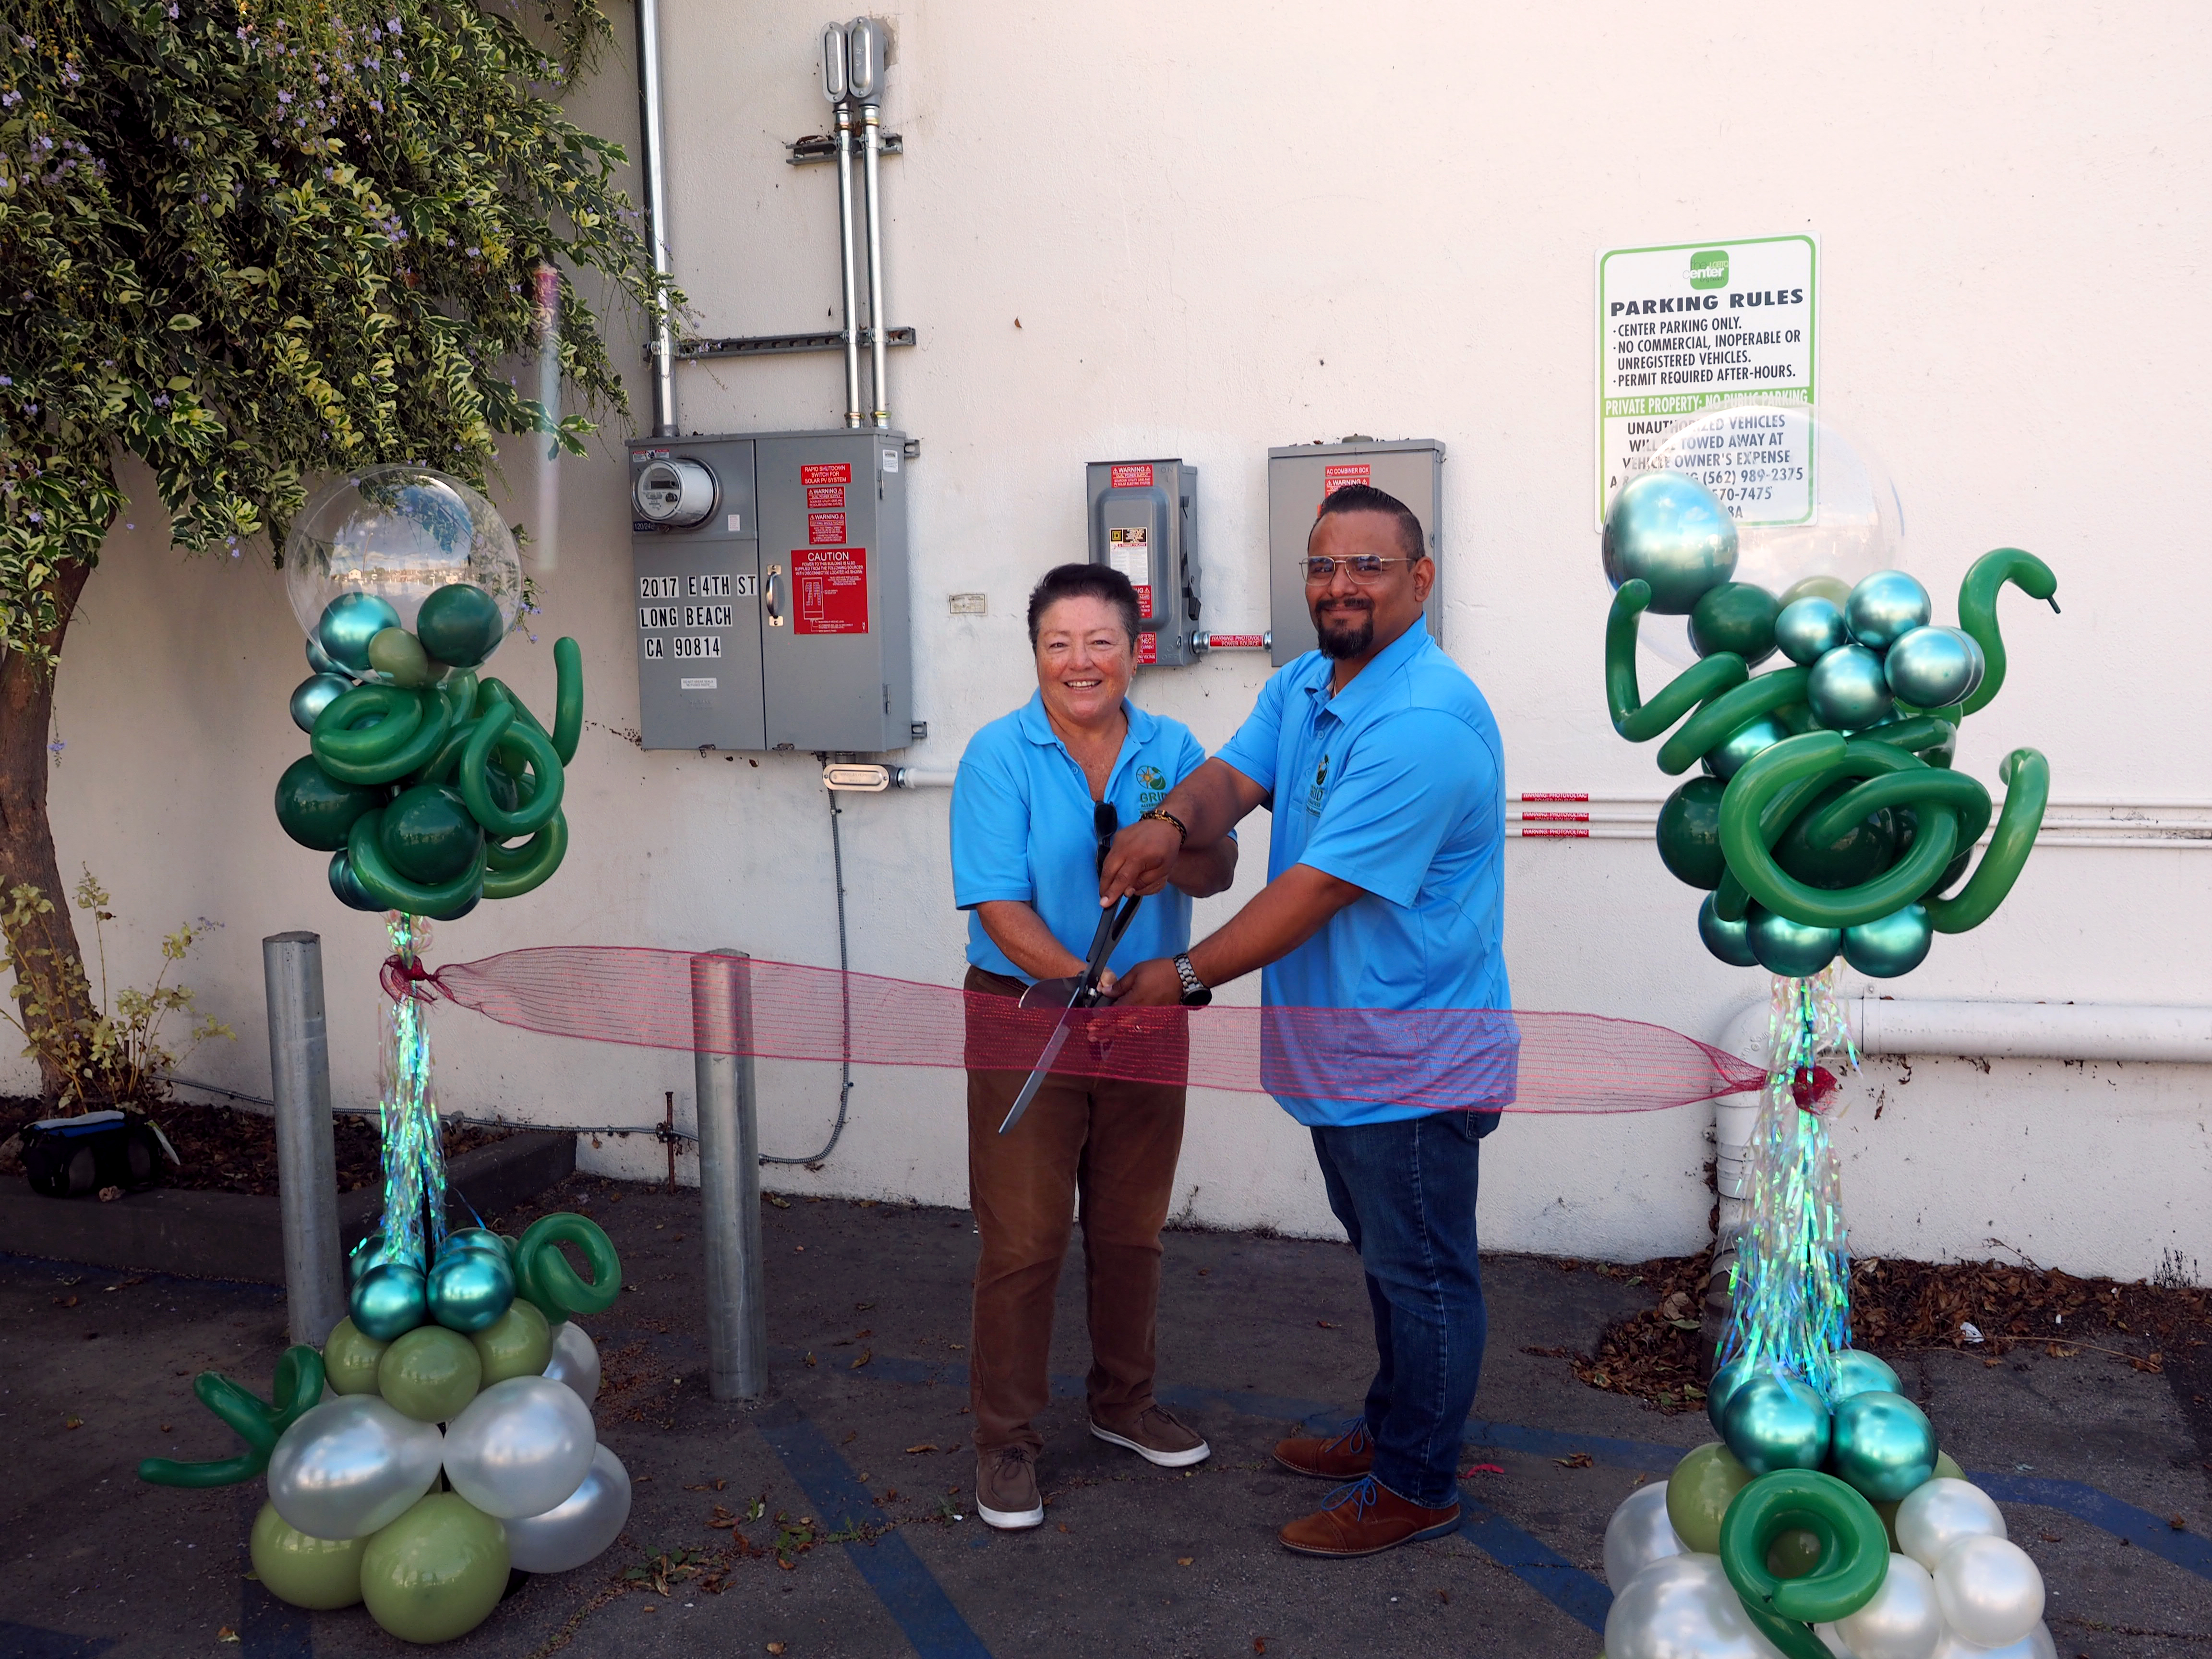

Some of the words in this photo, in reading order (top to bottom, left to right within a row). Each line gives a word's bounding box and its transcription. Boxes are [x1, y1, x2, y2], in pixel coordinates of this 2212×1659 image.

[1683, 266, 1724, 279] center
[1691, 259, 1707, 270] the
[1611, 295, 1718, 316] PARKING
[1730, 289, 1803, 309] RULES
[1618, 323, 1656, 337] CENTER
[1660, 320, 1707, 334] PARKING
[1712, 316, 1742, 330] ONLY.
[1618, 341, 1633, 353] NO
[1638, 336, 1711, 352] COMMERCIAL,
[1715, 331, 1781, 348] INOPERABLE
[1785, 330, 1801, 342] OR
[1618, 353, 1695, 370] UNREGISTERED
[1699, 350, 1751, 365] VEHICLES.
[1618, 373, 1657, 387] PERMIT
[1661, 370, 1713, 385] REQUIRED
[1717, 364, 1796, 381] AFTER-HOURS.
[1606, 398, 1645, 416] PRIVATE
[1648, 394, 1703, 413] PROPERTY:
[1706, 394, 1720, 408] NO
[1724, 391, 1759, 408] PUBLIC
[1762, 389, 1808, 406] PARKING
[1730, 415, 1785, 430] VEHICLES
[1629, 439, 1658, 452] WILL
[1682, 436, 1724, 450] TOWED
[1729, 433, 1765, 447] AWAY
[1768, 433, 1784, 445] AT
[1674, 453, 1732, 468] OWNER'S
[1737, 450, 1790, 465] EXPENSE
[1703, 471, 1736, 486] (562)
[1741, 467, 1803, 482] 989-2375
[807, 552, 849, 561] CAUTION
[642, 578, 677, 597] 2017
[689, 577, 696, 595] E
[703, 577, 730, 595] 4TH
[738, 576, 756, 594] ST
[641, 608, 677, 627] LONG
[686, 606, 731, 625] BEACH
[647, 639, 663, 657] CA
[675, 637, 720, 656] 90814
